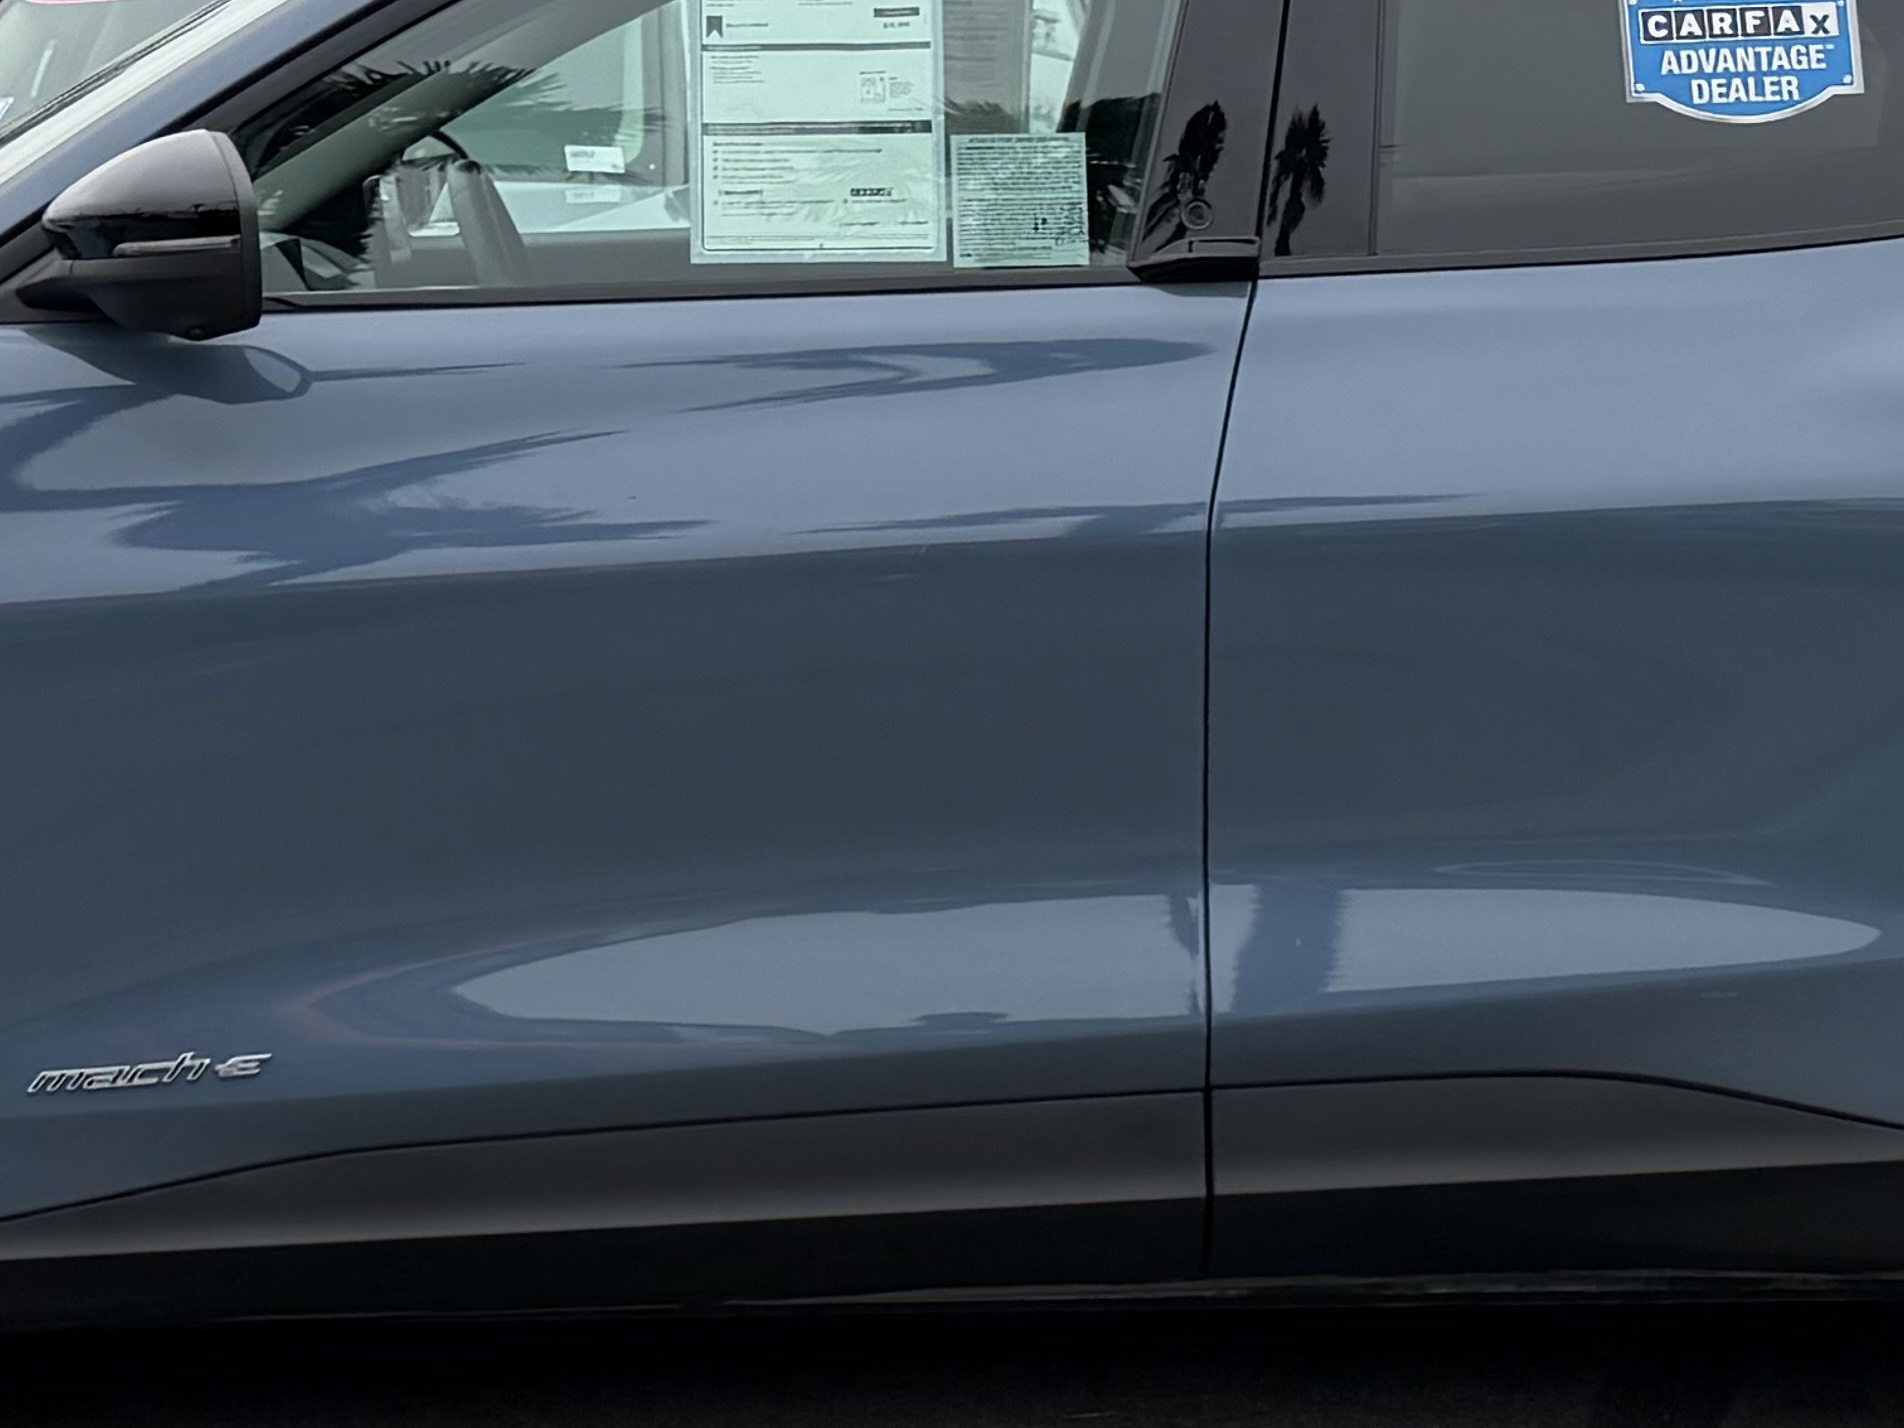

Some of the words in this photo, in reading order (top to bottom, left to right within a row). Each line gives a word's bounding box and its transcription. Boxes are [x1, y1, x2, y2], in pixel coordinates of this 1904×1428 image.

[1645, 7, 1832, 39] CARFAX
[1660, 44, 1829, 75] ADVANTAGE
[1690, 74, 1800, 104] DEALER
